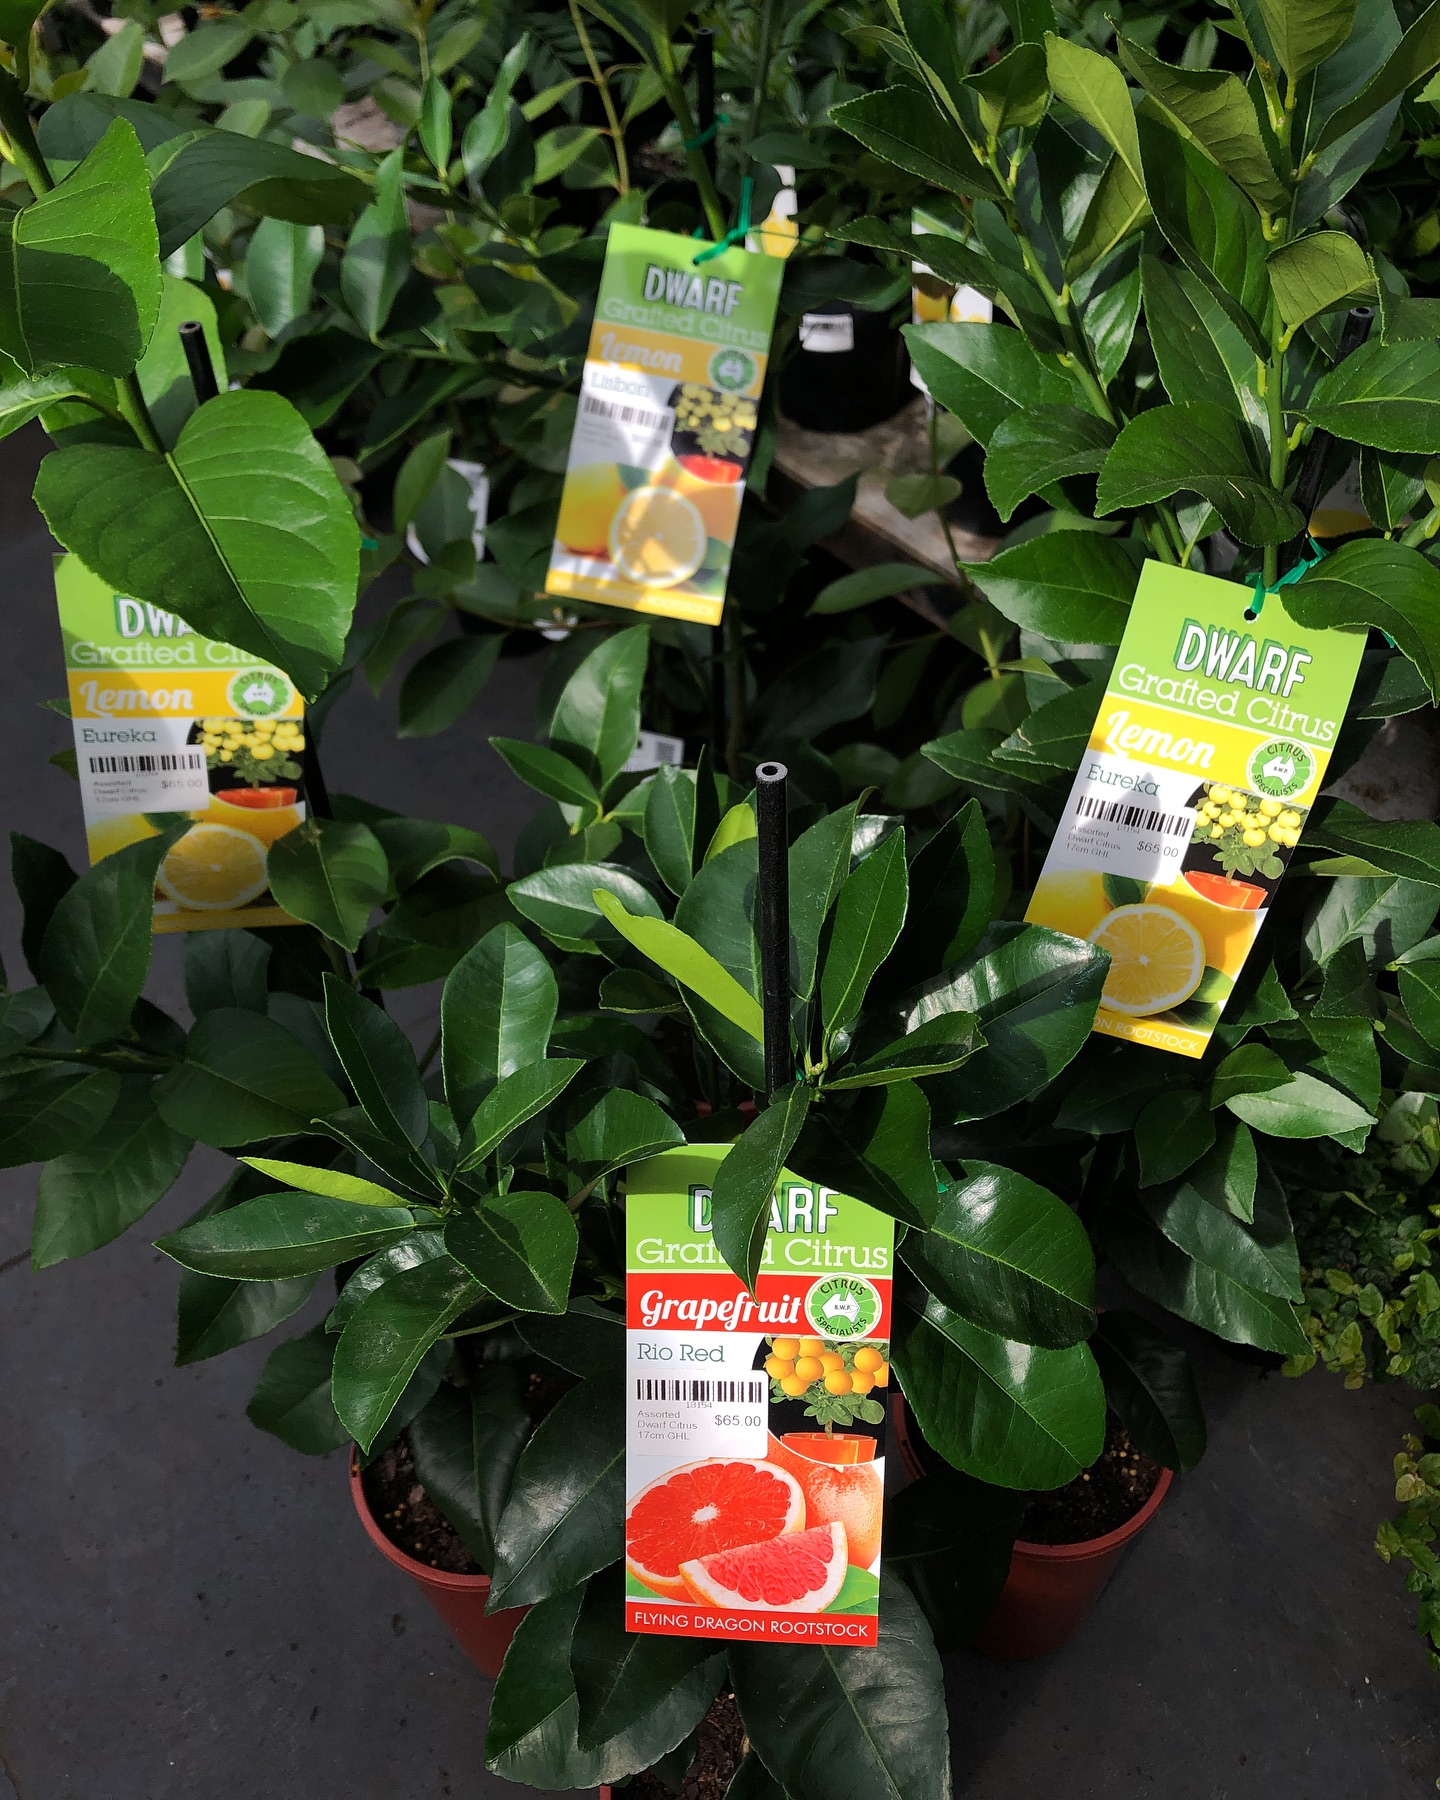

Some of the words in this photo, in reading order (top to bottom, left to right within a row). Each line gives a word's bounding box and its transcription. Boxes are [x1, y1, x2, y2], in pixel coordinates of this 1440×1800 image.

[643, 263, 744, 318] DWARF
[602, 298, 696, 333] Grafted
[700, 317, 768, 347] Citrus
[600, 332, 683, 373] Lemon
[591, 372, 650, 398] Lisbon
[115, 596, 195, 639] DWA
[71, 641, 197, 665] Grafted
[1175, 620, 1313, 698] DWARF
[79, 680, 194, 718] Lemon
[1119, 663, 1241, 718] Grafted
[1246, 697, 1336, 742] Citrus
[82, 728, 157, 743] Eureka
[1104, 710, 1216, 769] Lemon
[1267, 742, 1307, 762] CITRUS
[1085, 763, 1161, 797] Eureka
[1255, 774, 1298, 797] SPECIALISTS
[1071, 824, 1109, 838] Assorted
[1115, 1022, 1198, 1052] ROOTSTOCK
[690, 1185, 840, 1233] DARF
[636, 1238, 774, 1264] Grafd
[785, 1239, 888, 1268] Citrus
[820, 1279, 866, 1295] CITRUS
[640, 1290, 801, 1330] Grapefruit
[817, 1316, 867, 1336] SPECIALISTS
[637, 1342, 673, 1361] Rio
[679, 1344, 725, 1362] Red
[637, 1410, 680, 1418] Assorted
[637, 1420, 666, 1429] Dwarf
[669, 1421, 698, 1429] Citrus
[714, 1415, 761, 1427] $65.00
[638, 1431, 665, 1439] 17cm
[667, 1431, 690, 1440] GHL
[634, 1611, 689, 1628] FLYING
[694, 1616, 765, 1633] DRAGON
[770, 1620, 868, 1637] ROOTSTOCK
